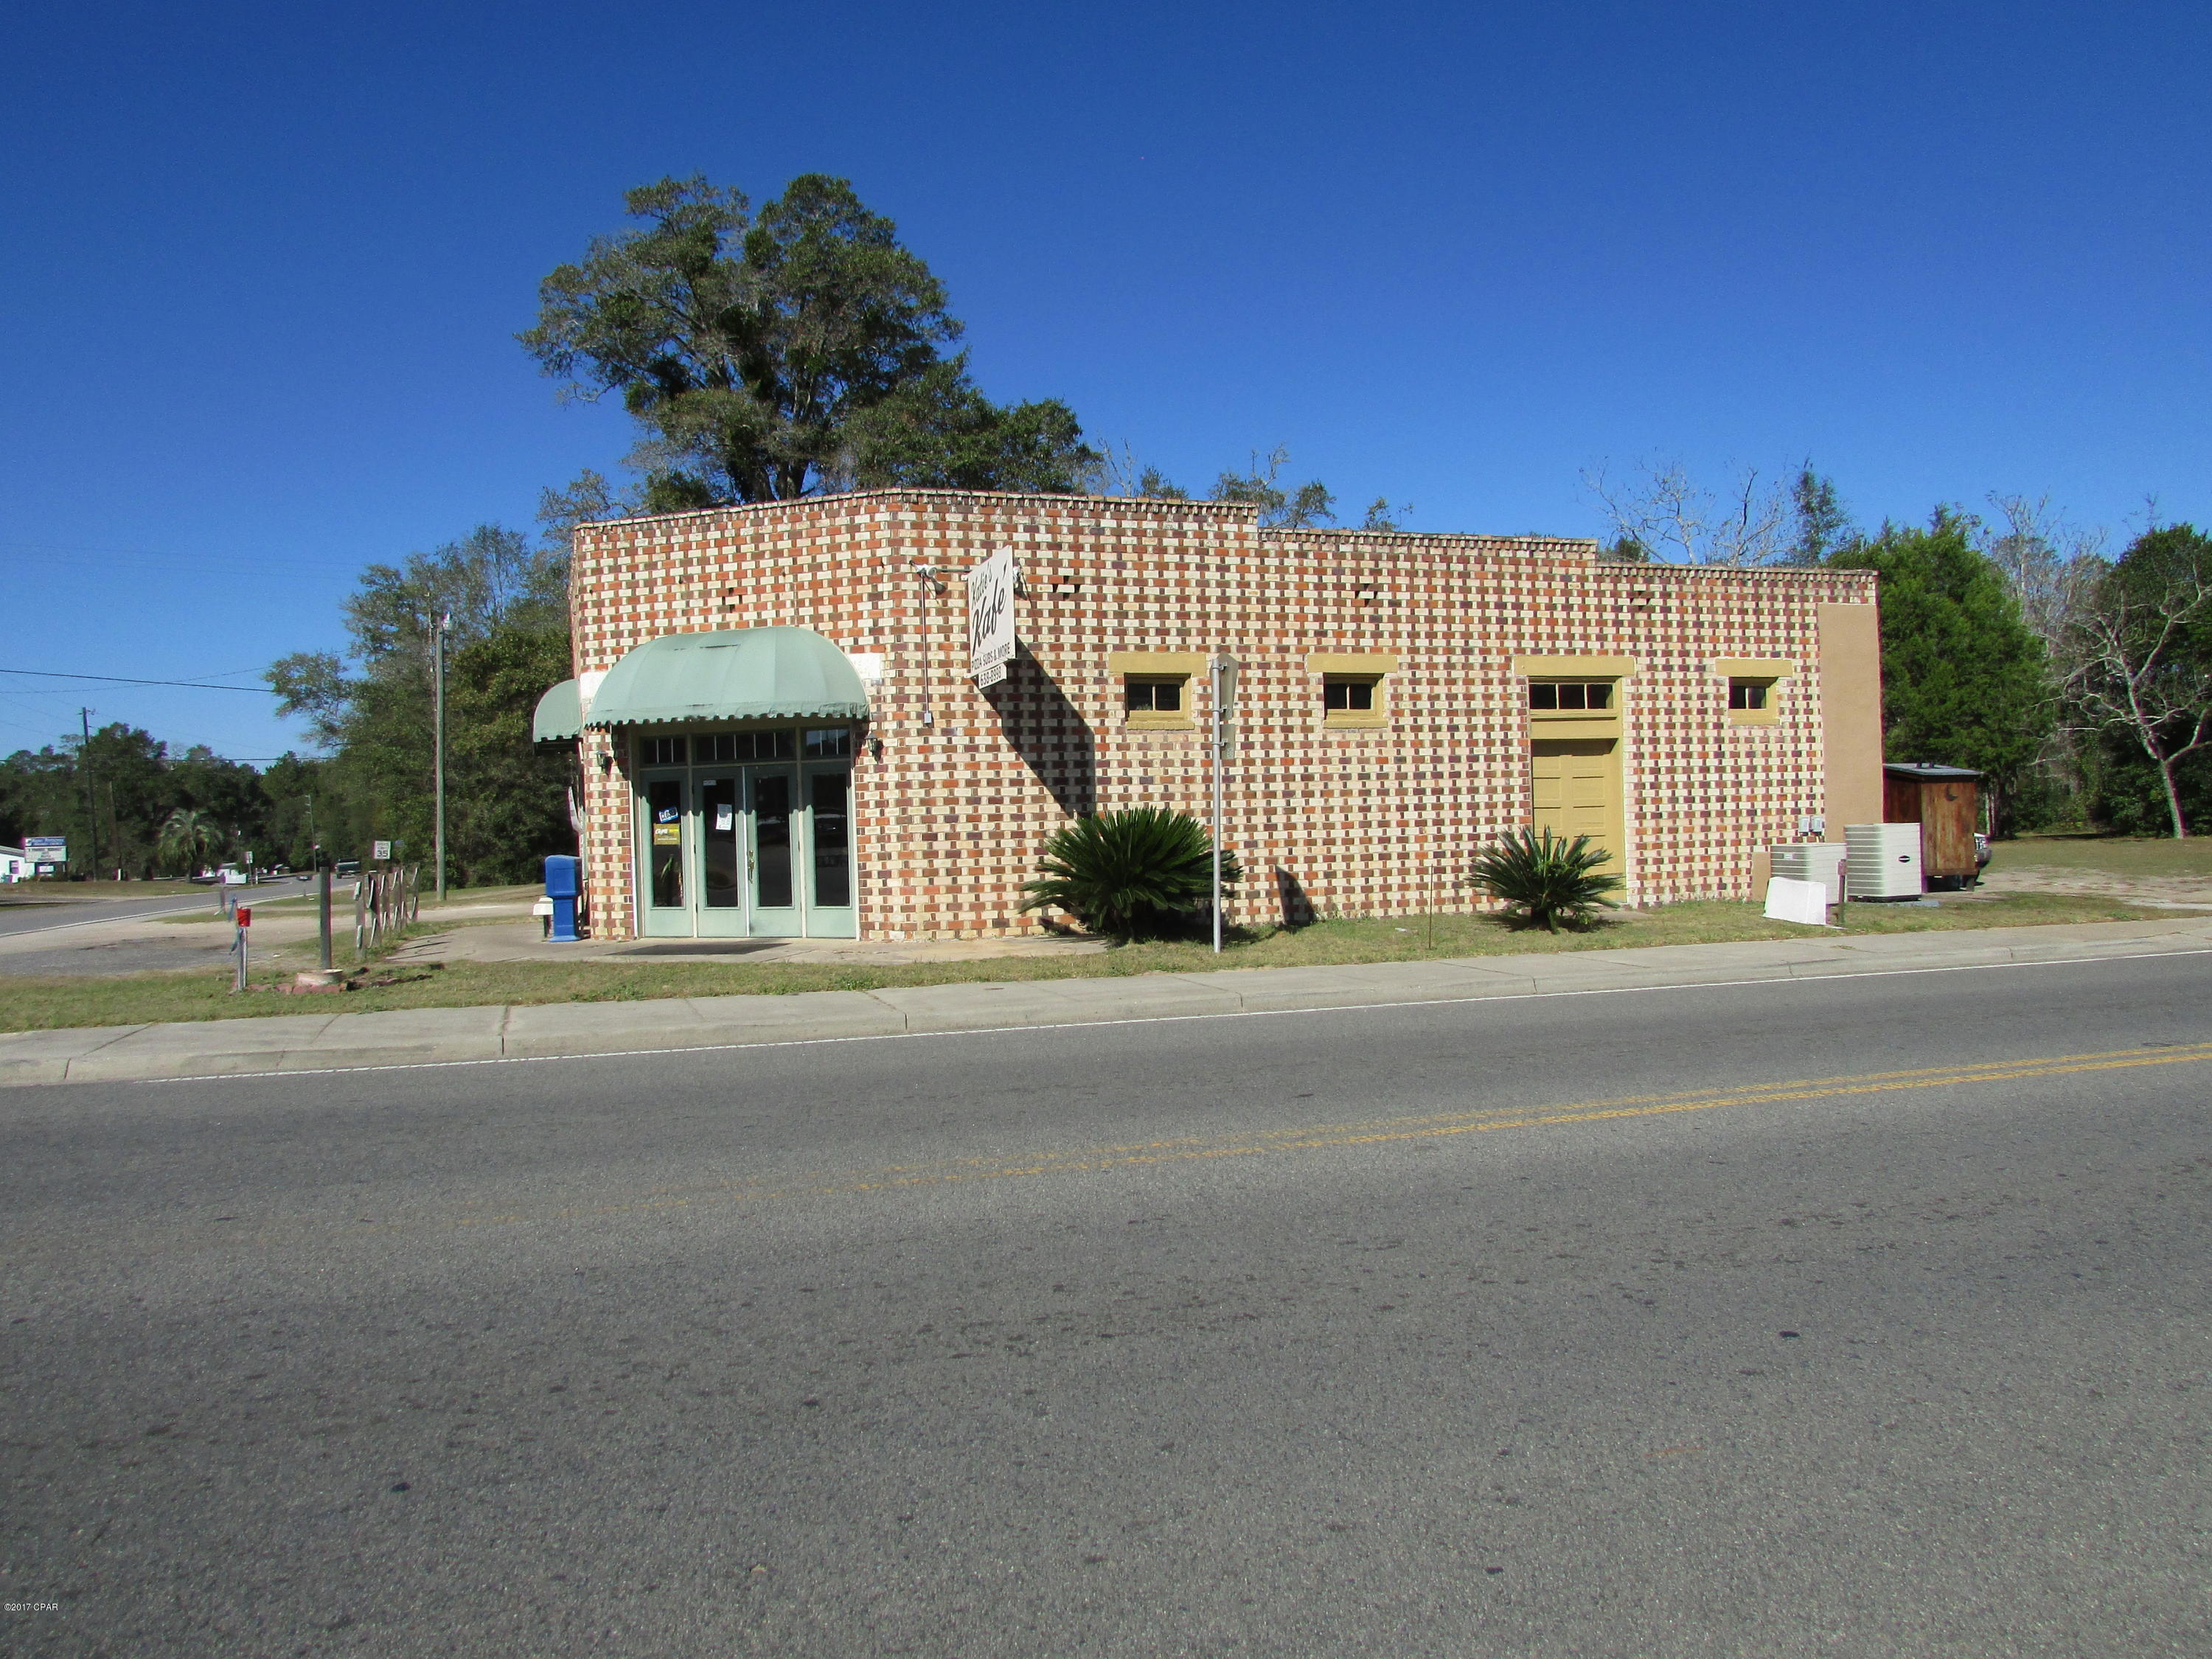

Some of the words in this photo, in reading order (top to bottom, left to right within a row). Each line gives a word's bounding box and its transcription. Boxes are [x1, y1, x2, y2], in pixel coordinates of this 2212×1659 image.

[971, 561, 992, 611] Katie's
[971, 656, 983, 672] PIZZA
[983, 650, 993, 667] SUBS
[998, 641, 1010, 658] MORE
